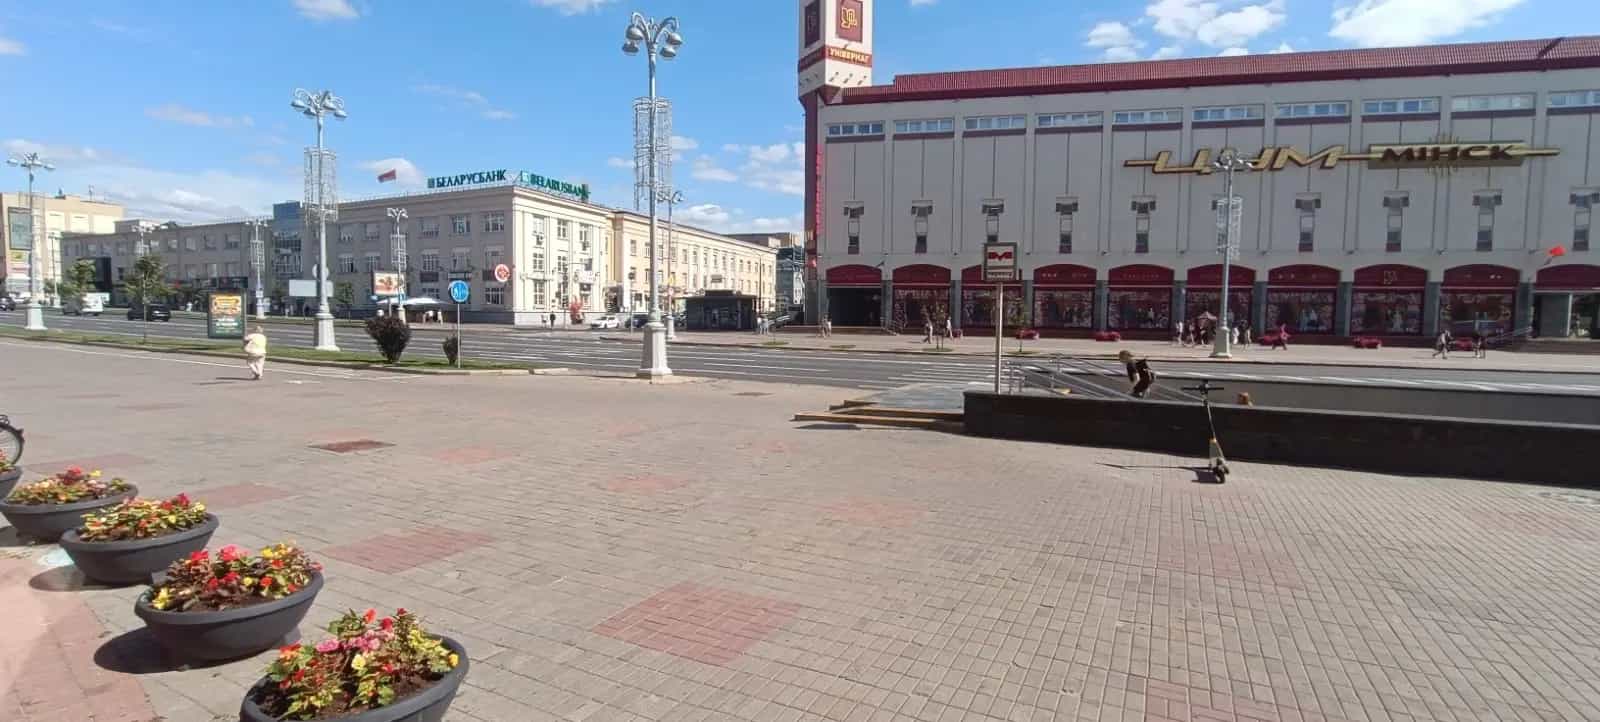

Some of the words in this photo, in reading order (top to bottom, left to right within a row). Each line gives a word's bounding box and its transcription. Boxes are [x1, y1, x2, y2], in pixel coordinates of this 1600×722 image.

[1151, 145, 1345, 175] ЦУМ
[1381, 144, 1520, 162] МІНСК
[436, 168, 506, 188] БЕЛАРУСБАНК
